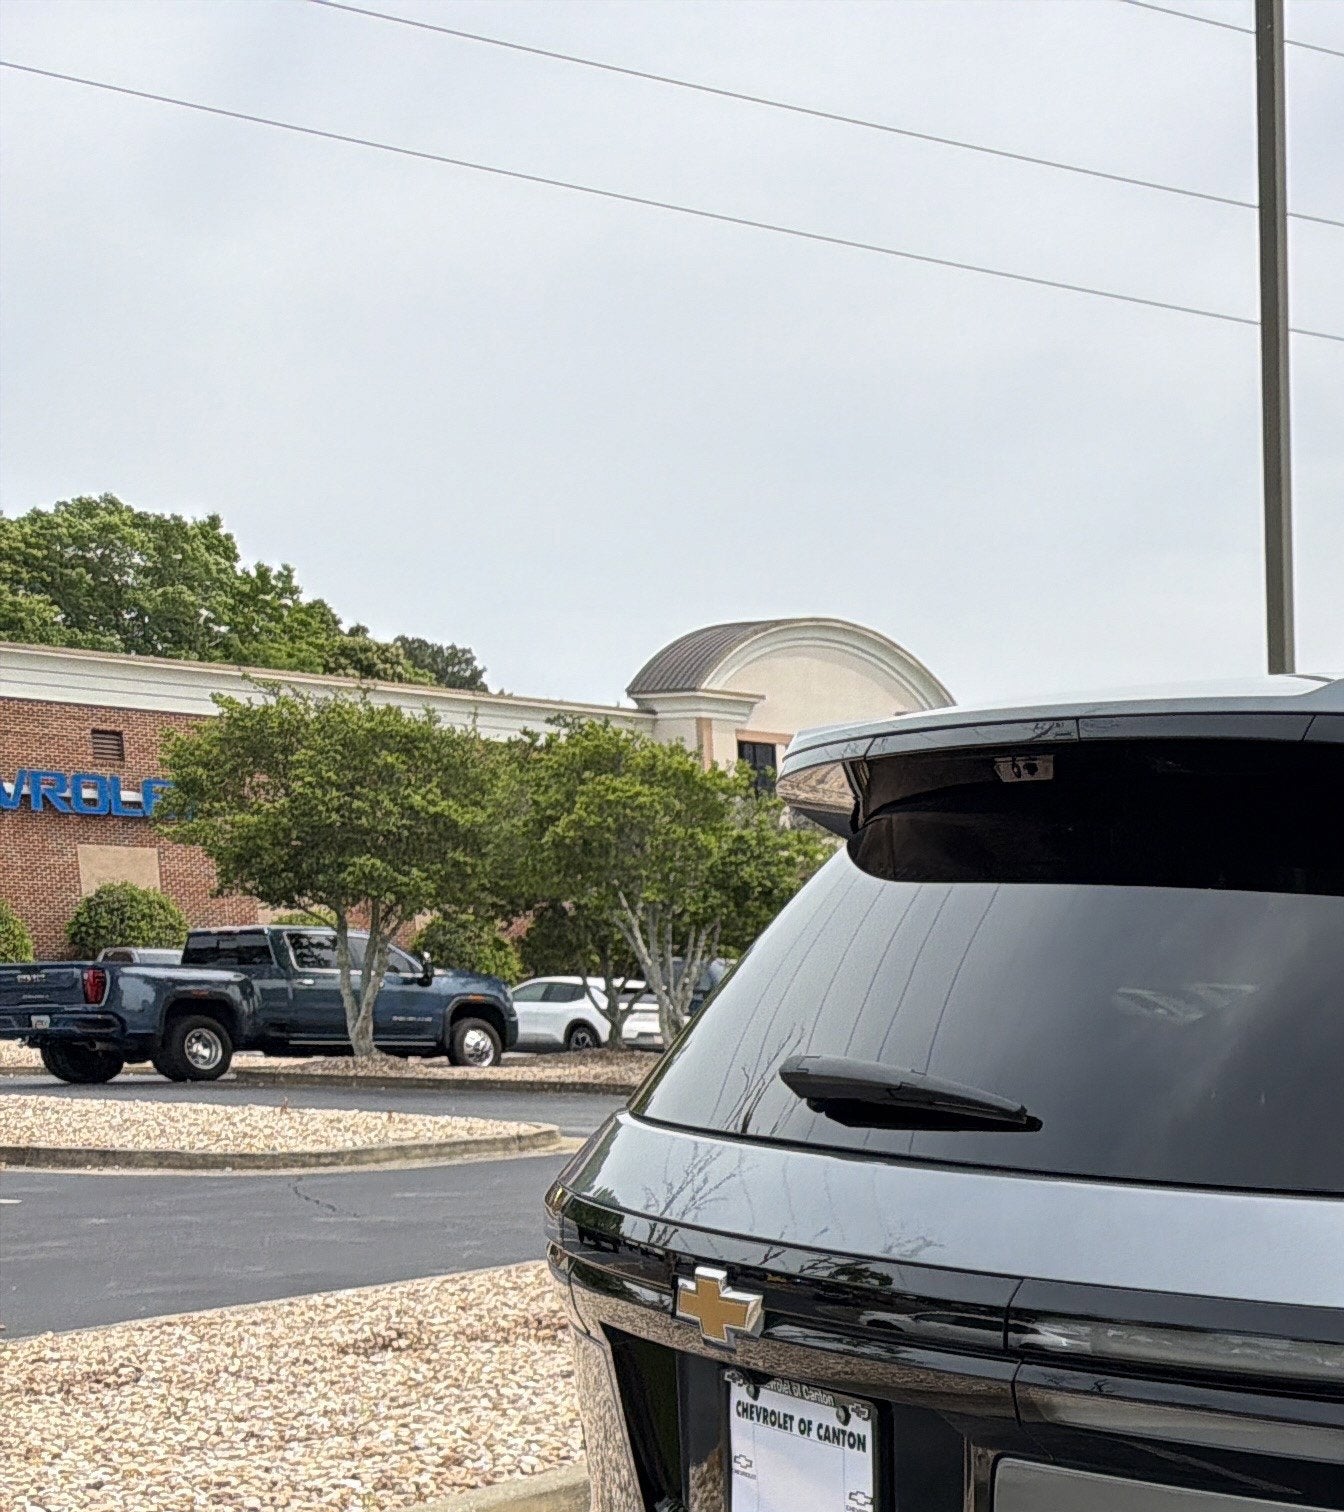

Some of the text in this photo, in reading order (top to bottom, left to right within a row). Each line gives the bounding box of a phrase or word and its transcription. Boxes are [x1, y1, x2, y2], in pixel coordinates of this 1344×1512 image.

[736, 1400, 867, 1453] CHEVROLET OF CANTON
